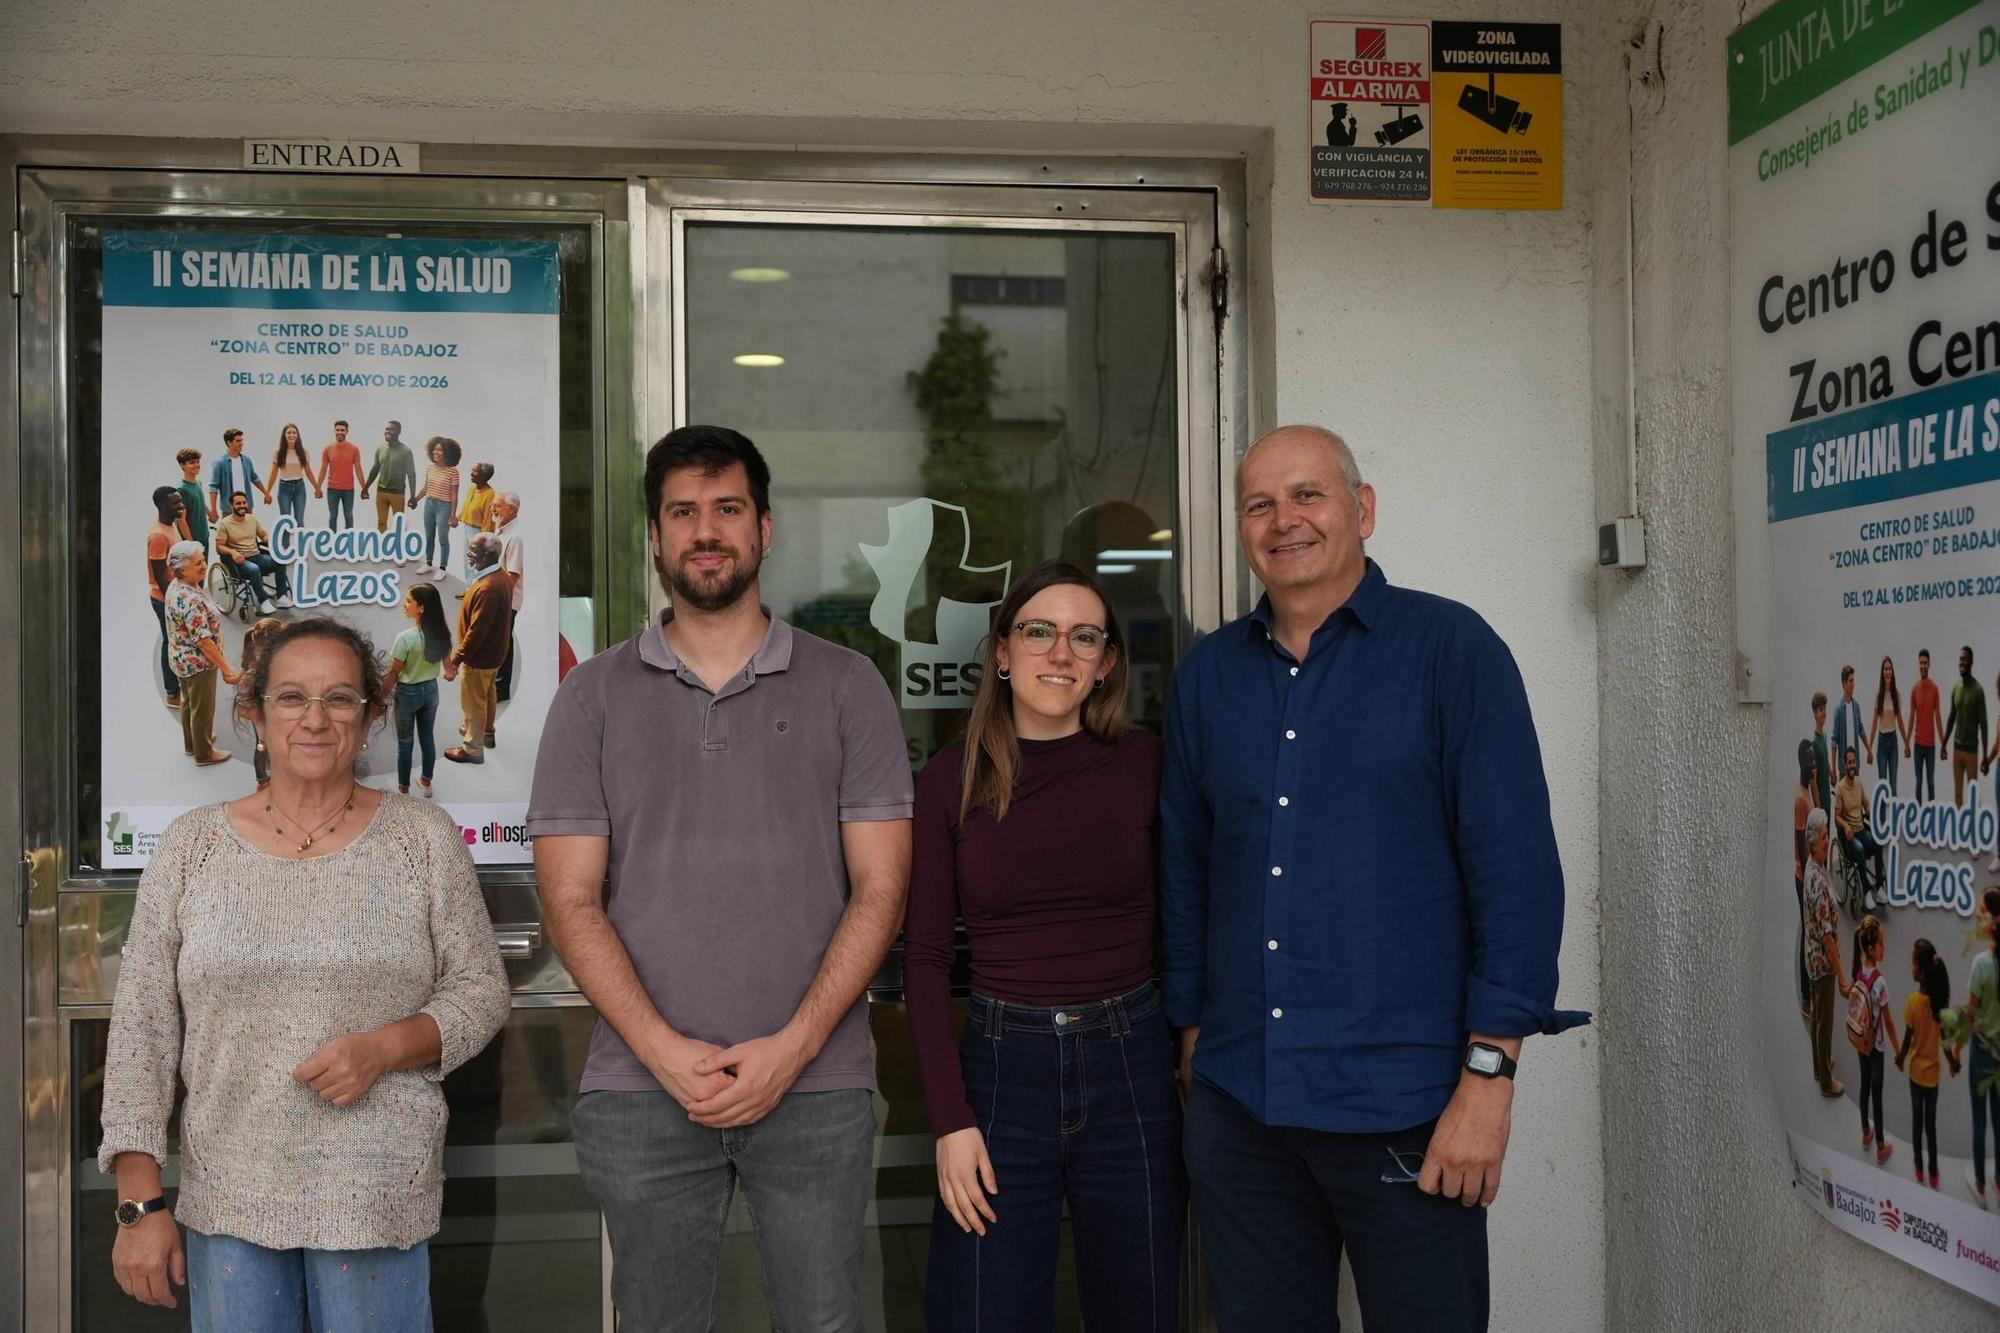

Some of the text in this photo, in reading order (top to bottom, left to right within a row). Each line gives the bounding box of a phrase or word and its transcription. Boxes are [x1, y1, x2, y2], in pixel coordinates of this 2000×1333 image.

[1477, 31, 1516, 46] ZONA
[1320, 59, 1422, 78] SEGUREX
[1442, 50, 1551, 66] VIDEOVIGILADA
[1759, 5, 1836, 104] JUNTA
[1321, 81, 1421, 100] ALARMA
[1758, 25, 2000, 182] Consejería de Sanidad y D
[251, 143, 402, 168] ENTRADA
[1317, 152, 1424, 163] CON VIGILANCIA Y
[1313, 168, 1428, 179] VERIFICACION 24 H.
[153, 250, 512, 294] II SEMANA DE LA SALUD
[1758, 249, 1895, 334] Centro
[1910, 209, 1968, 279] de
[258, 323, 409, 339] CENTRO DE SALUD
[354, 342, 375, 356] DE
[380, 344, 458, 358] BADAJOZ
[230, 372, 449, 388] DEL 12 AL 16 DE MAYO DE 2026
[1790, 320, 2000, 423] Zona Cen
[1793, 446, 1806, 493] II
[1811, 423, 1902, 489] SEMANA
[1908, 413, 1938, 469] DE
[1944, 404, 1974, 460] LA
[272, 515, 423, 561] Creando
[1860, 506, 1974, 541] CENTRO DE SALUD
[1933, 536, 1948, 556] DE
[1952, 528, 2000, 552] BADAJ
[298, 563, 397, 604] Lazos
[1844, 592, 1860, 608] DEL
[1863, 590, 1874, 606] 12
[1876, 588, 1890, 606] AL
[1892, 586, 1904, 604] 16
[1906, 584, 1919, 602] DE
[1922, 580, 1956, 600] MAYO
[1958, 578, 1974, 597] DE
[906, 662, 984, 697] SES
[1872, 783, 1994, 849] Creando
[114, 844, 132, 853] SES
[1890, 845, 1972, 911] Lazos
[1836, 1191, 1877, 1224] Badajoz
[1912, 1227, 1948, 1252] BADAJOZ
